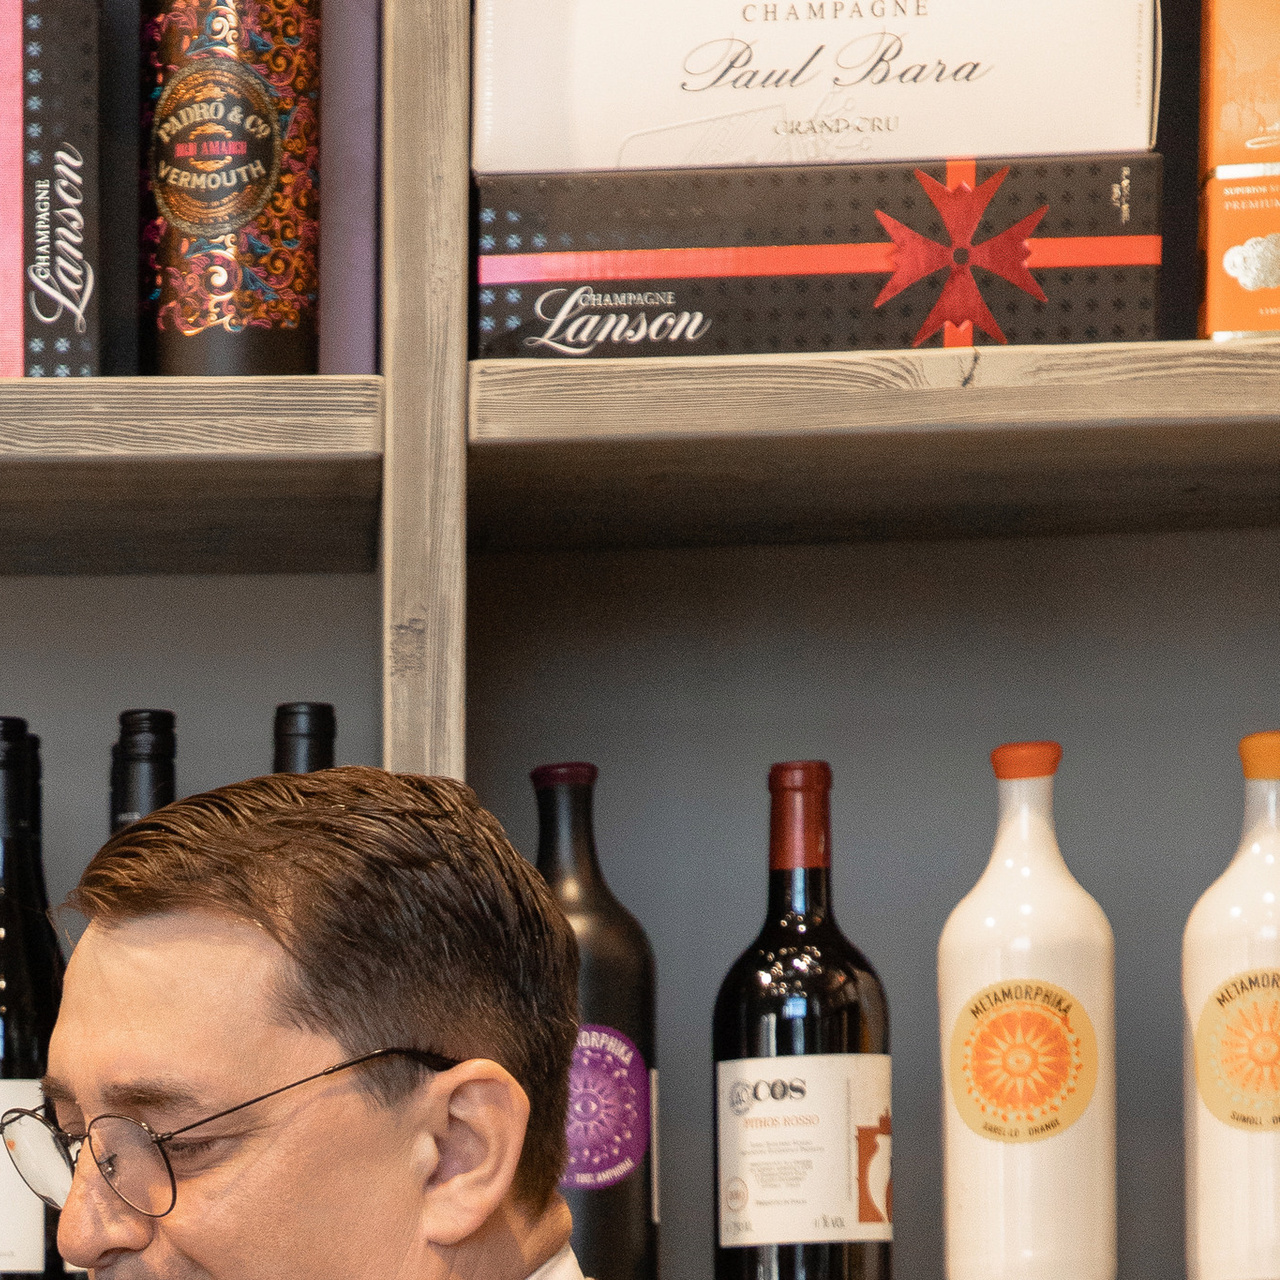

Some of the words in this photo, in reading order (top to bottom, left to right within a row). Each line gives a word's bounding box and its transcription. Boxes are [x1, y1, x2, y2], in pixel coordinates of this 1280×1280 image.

[742, 0, 929, 22] CHAMPAGNE
[681, 36, 825, 92] Paul
[833, 31, 994, 86] Bara
[227, 105, 244, 124] &
[772, 119, 850, 136] GRAND
[854, 116, 900, 133] CRU
[158, 160, 266, 190] VERMOUTH
[27, 142, 94, 333] Lanson
[37, 179, 50, 278] CHAMPAGNE
[579, 289, 676, 308] CHAMPAGNE
[526, 286, 713, 355] Lanson
[970, 983, 1073, 1020] METAMORPHIKA
[783, 1114, 820, 1126] ROSSO
